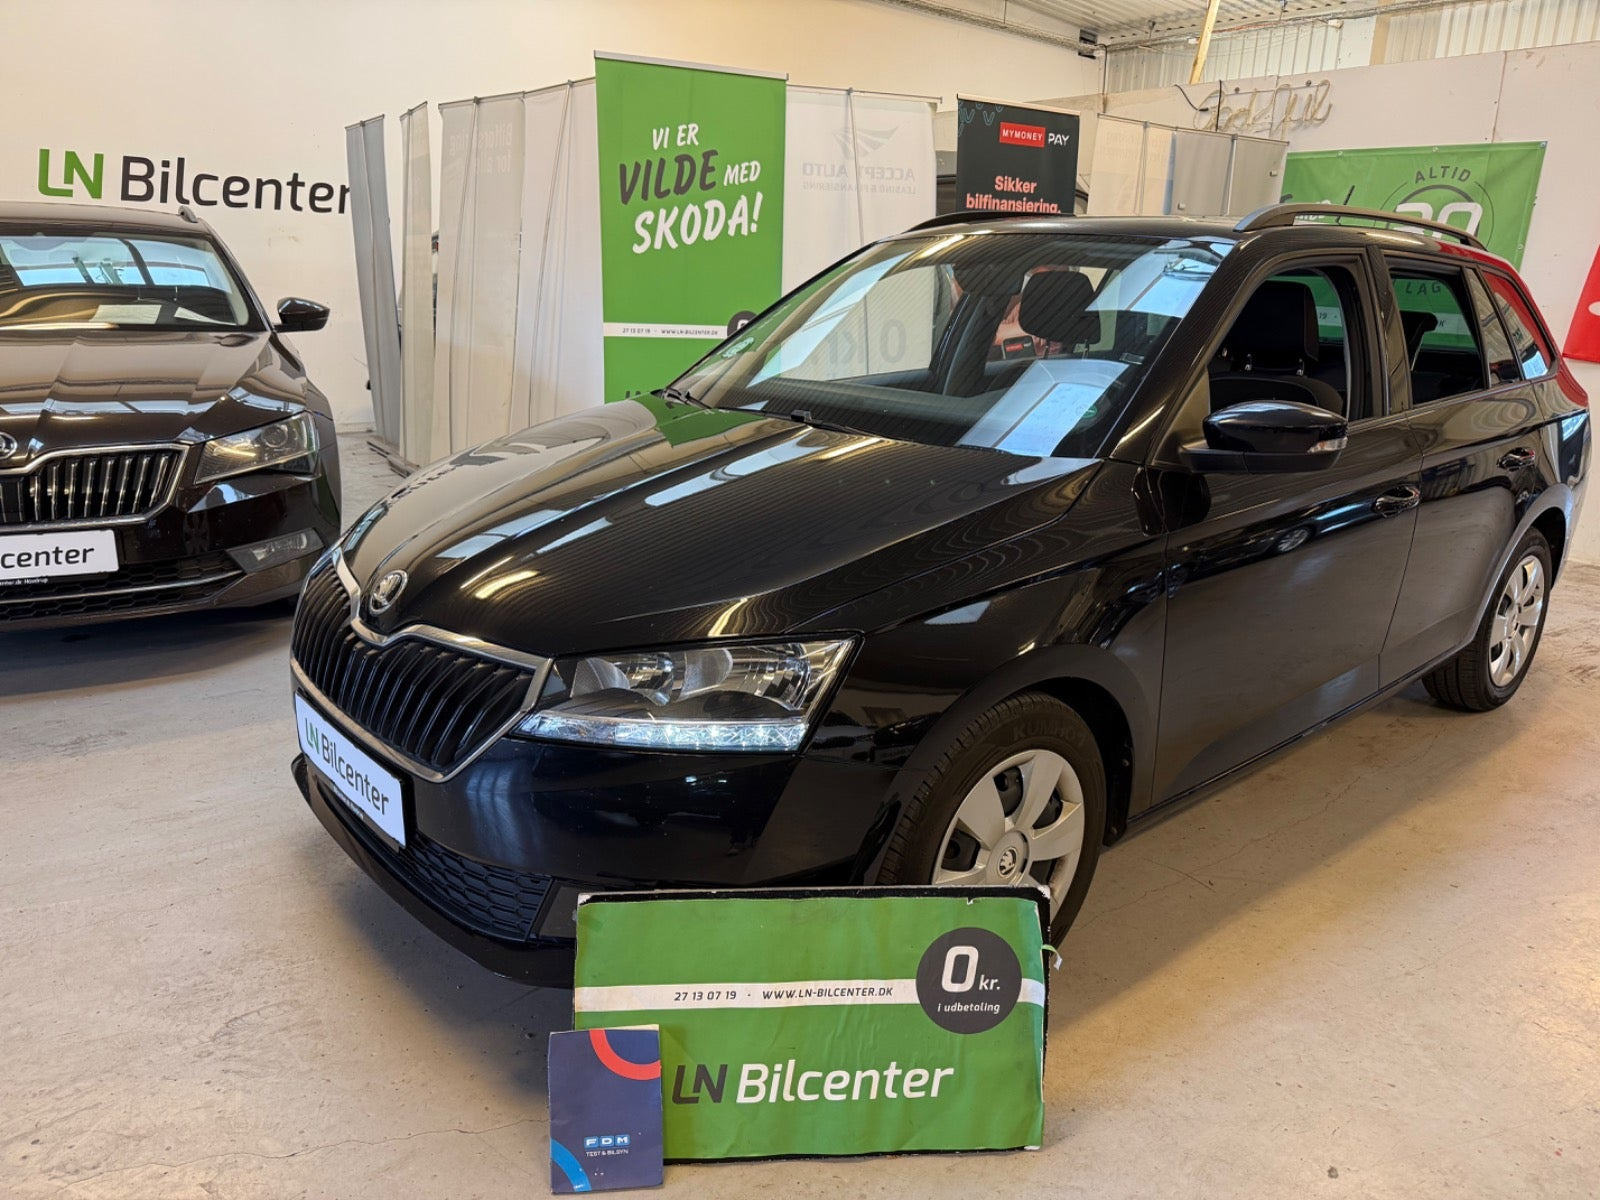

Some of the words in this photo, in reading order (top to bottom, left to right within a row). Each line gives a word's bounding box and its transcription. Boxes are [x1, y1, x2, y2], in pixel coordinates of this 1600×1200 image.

[652, 126, 670, 151] VI
[676, 123, 699, 147] ER
[1002, 128, 1043, 141] MYMONEY
[1048, 132, 1070, 146] PAY
[38, 148, 104, 199] LN
[120, 155, 350, 214] Bilcenter
[619, 149, 719, 206] VILDE
[723, 160, 761, 187] MED
[994, 175, 1038, 194] Sikker
[1415, 165, 1471, 184] ALTID
[632, 191, 764, 255] SKODA!
[304, 717, 320, 754] LN
[321, 733, 390, 816] Bilcenter
[941, 945, 979, 993] 0
[978, 974, 1001, 991] kr.
[674, 991, 689, 1001] 27
[692, 991, 703, 1001] 13
[707, 991, 721, 1000] 07
[725, 990, 737, 1000] 19
[762, 986, 894, 1000] WWW.LN-BILCENTER.DK
[937, 1002, 942, 1012] i
[944, 1002, 1001, 1015] udbetaling
[671, 1063, 728, 1105] LN
[736, 1059, 954, 1104] Bilcenter
